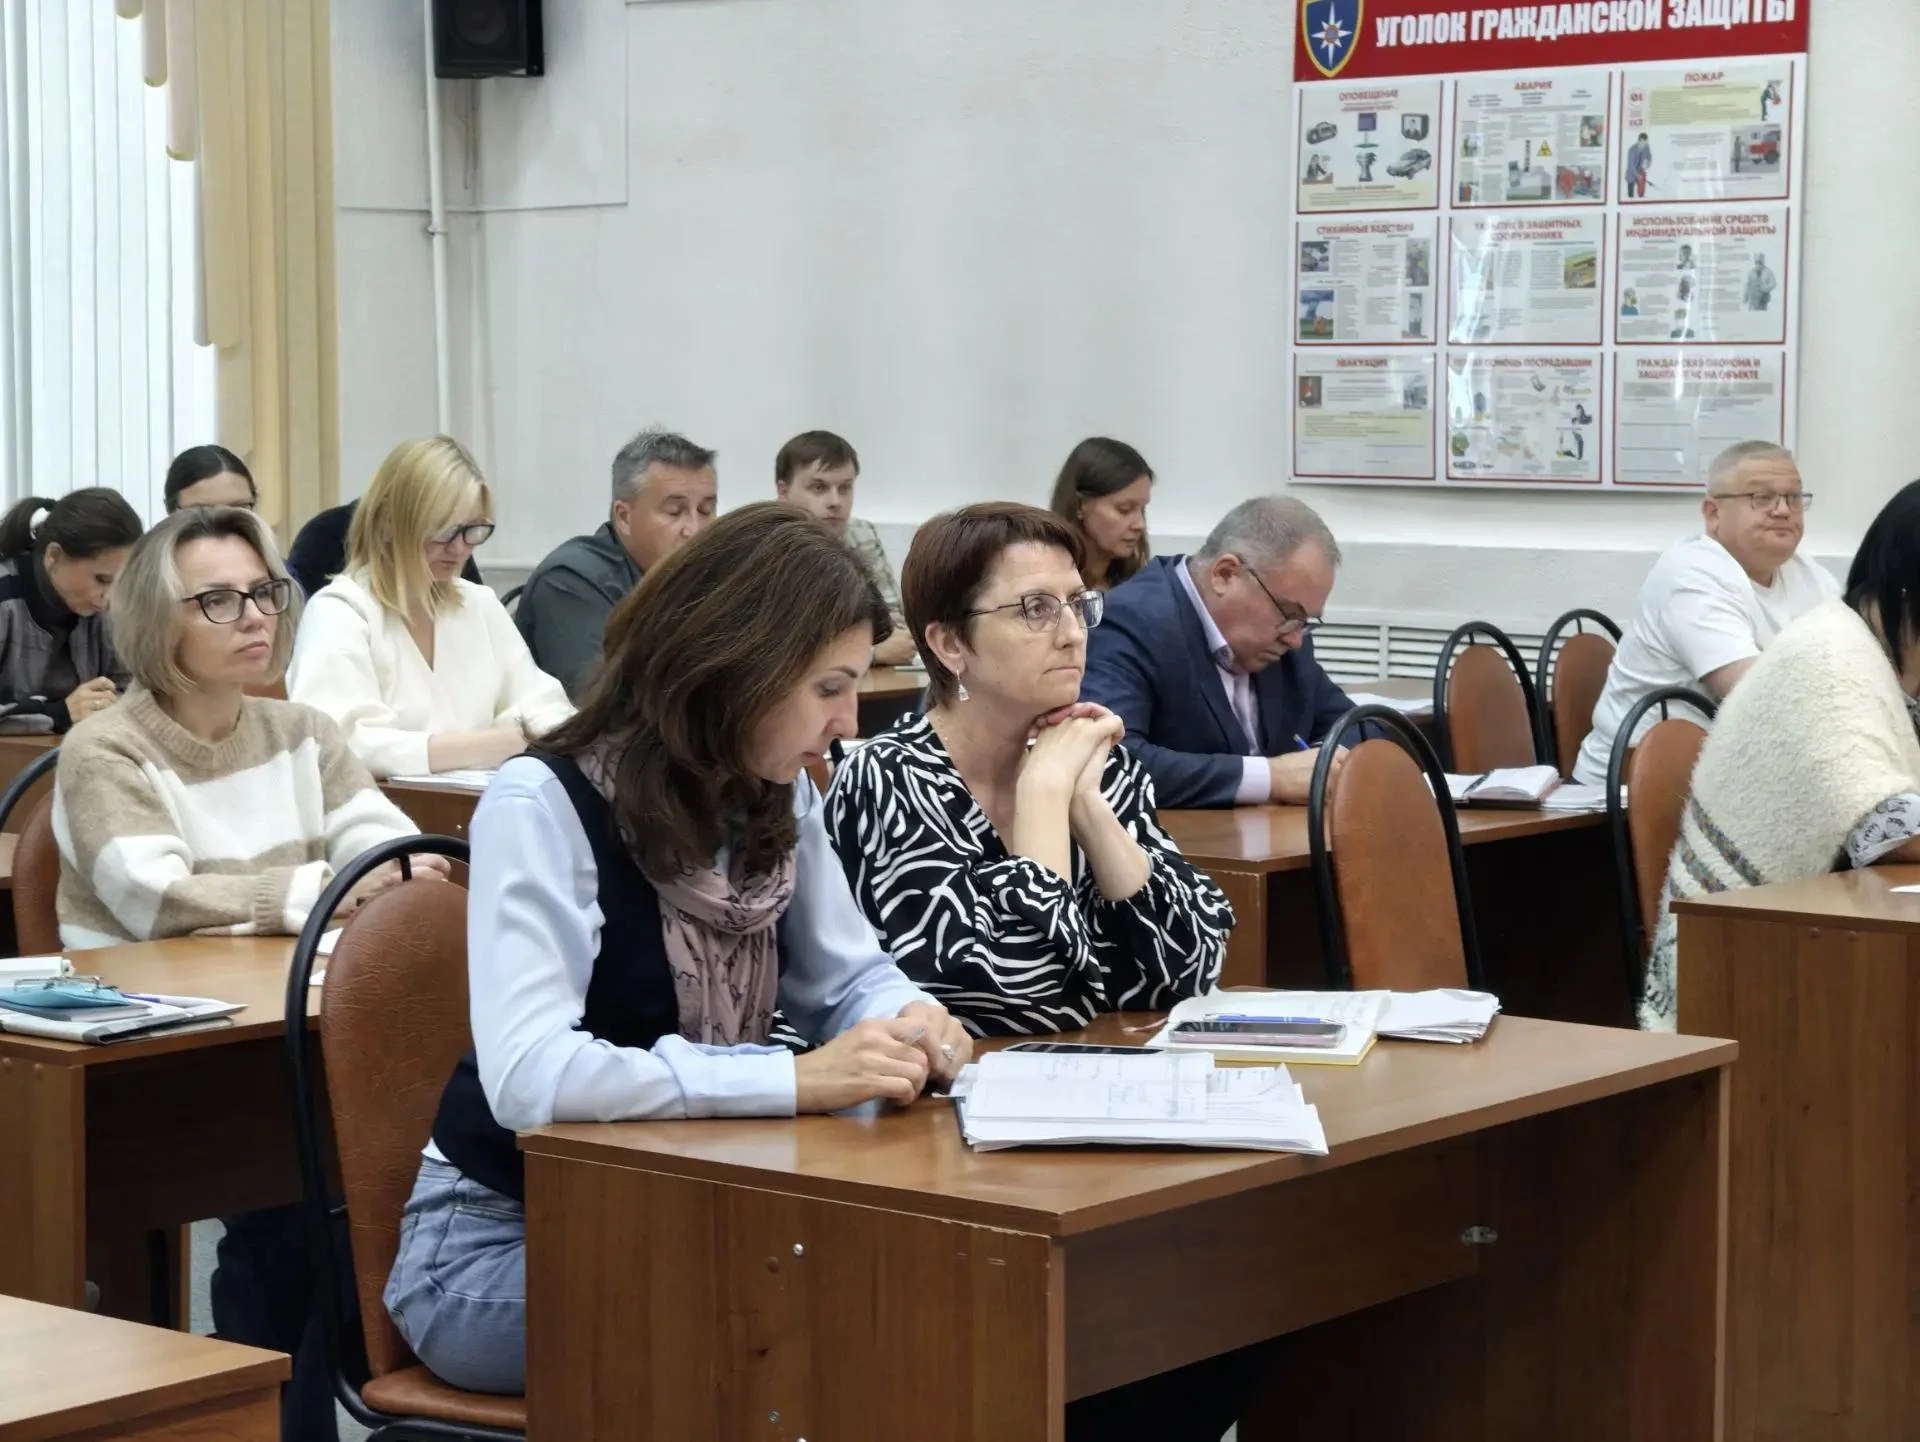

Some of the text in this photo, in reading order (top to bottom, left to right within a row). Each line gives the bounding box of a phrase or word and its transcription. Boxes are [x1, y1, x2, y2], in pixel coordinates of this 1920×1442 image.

[1376, 0, 1795, 47] УГОЛОК ГРАЖДАНСКОЙ ЗАЩИТЫ
[1685, 72, 1724, 82] ПОЖАР
[1514, 81, 1552, 90] АВАРИЯ
[1725, 214, 1768, 225] СРЕДСТВ
[1730, 225, 1776, 237] ЗАЩИТЫ
